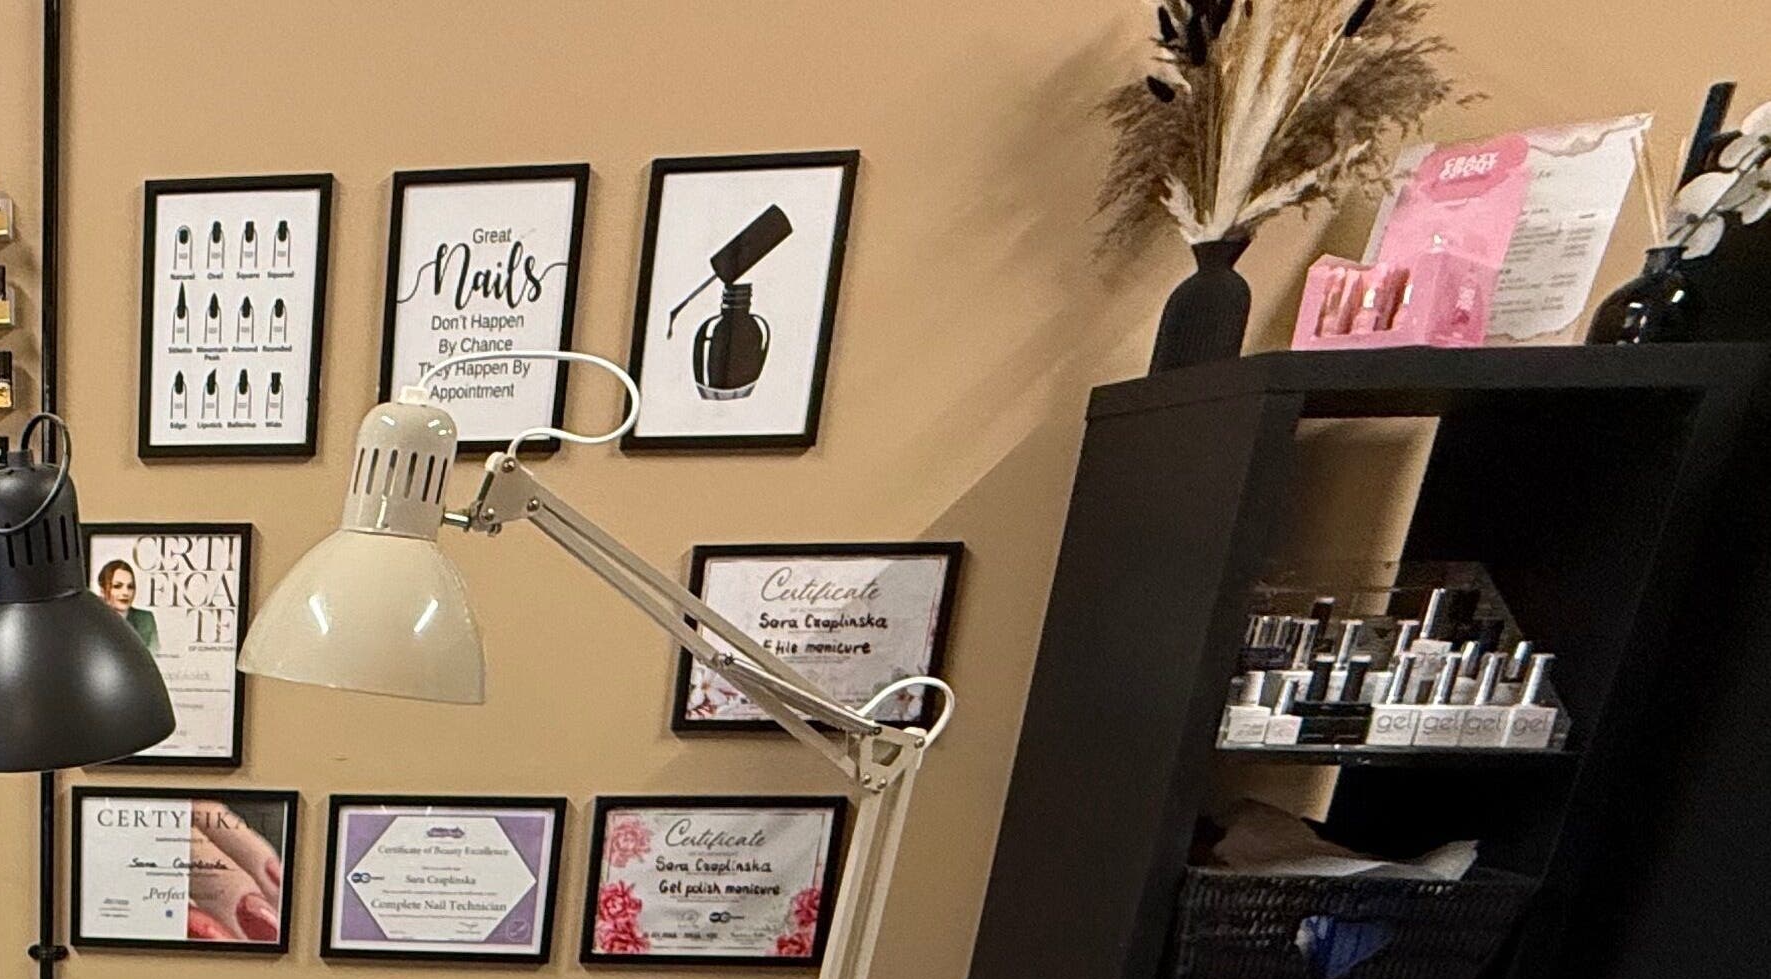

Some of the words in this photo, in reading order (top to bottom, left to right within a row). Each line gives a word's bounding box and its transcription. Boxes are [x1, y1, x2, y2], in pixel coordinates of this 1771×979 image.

[472, 227, 512, 244] Great
[420, 241, 552, 311] Nails
[431, 313, 467, 331] Don't
[471, 312, 524, 334] Happen
[438, 338, 456, 357] By
[460, 336, 513, 354] Chance
[455, 361, 508, 380] Happen
[513, 359, 530, 377] By
[429, 384, 515, 404] Appointment
[133, 535, 236, 572] CERTI
[149, 571, 236, 608] FICA
[761, 566, 882, 605] Certificate
[187, 608, 236, 644] TE
[806, 640, 871, 655] manicure
[1377, 712, 1412, 733] gel
[1423, 714, 1459, 735] gel
[1465, 714, 1501, 735] gel
[1512, 715, 1549, 736] gel
[666, 819, 767, 850] Certificate
[377, 845, 421, 855] Certificate
[423, 845, 433, 855] of
[434, 846, 462, 857] Beauty
[465, 846, 510, 857] Excellence
[405, 875, 425, 885] Sara
[659, 879, 682, 894] Gel
[685, 881, 721, 897] polish
[725, 883, 781, 896] manicure
[370, 898, 422, 911] Complete
[425, 899, 447, 911] Nail
[450, 900, 508, 912] Technician
